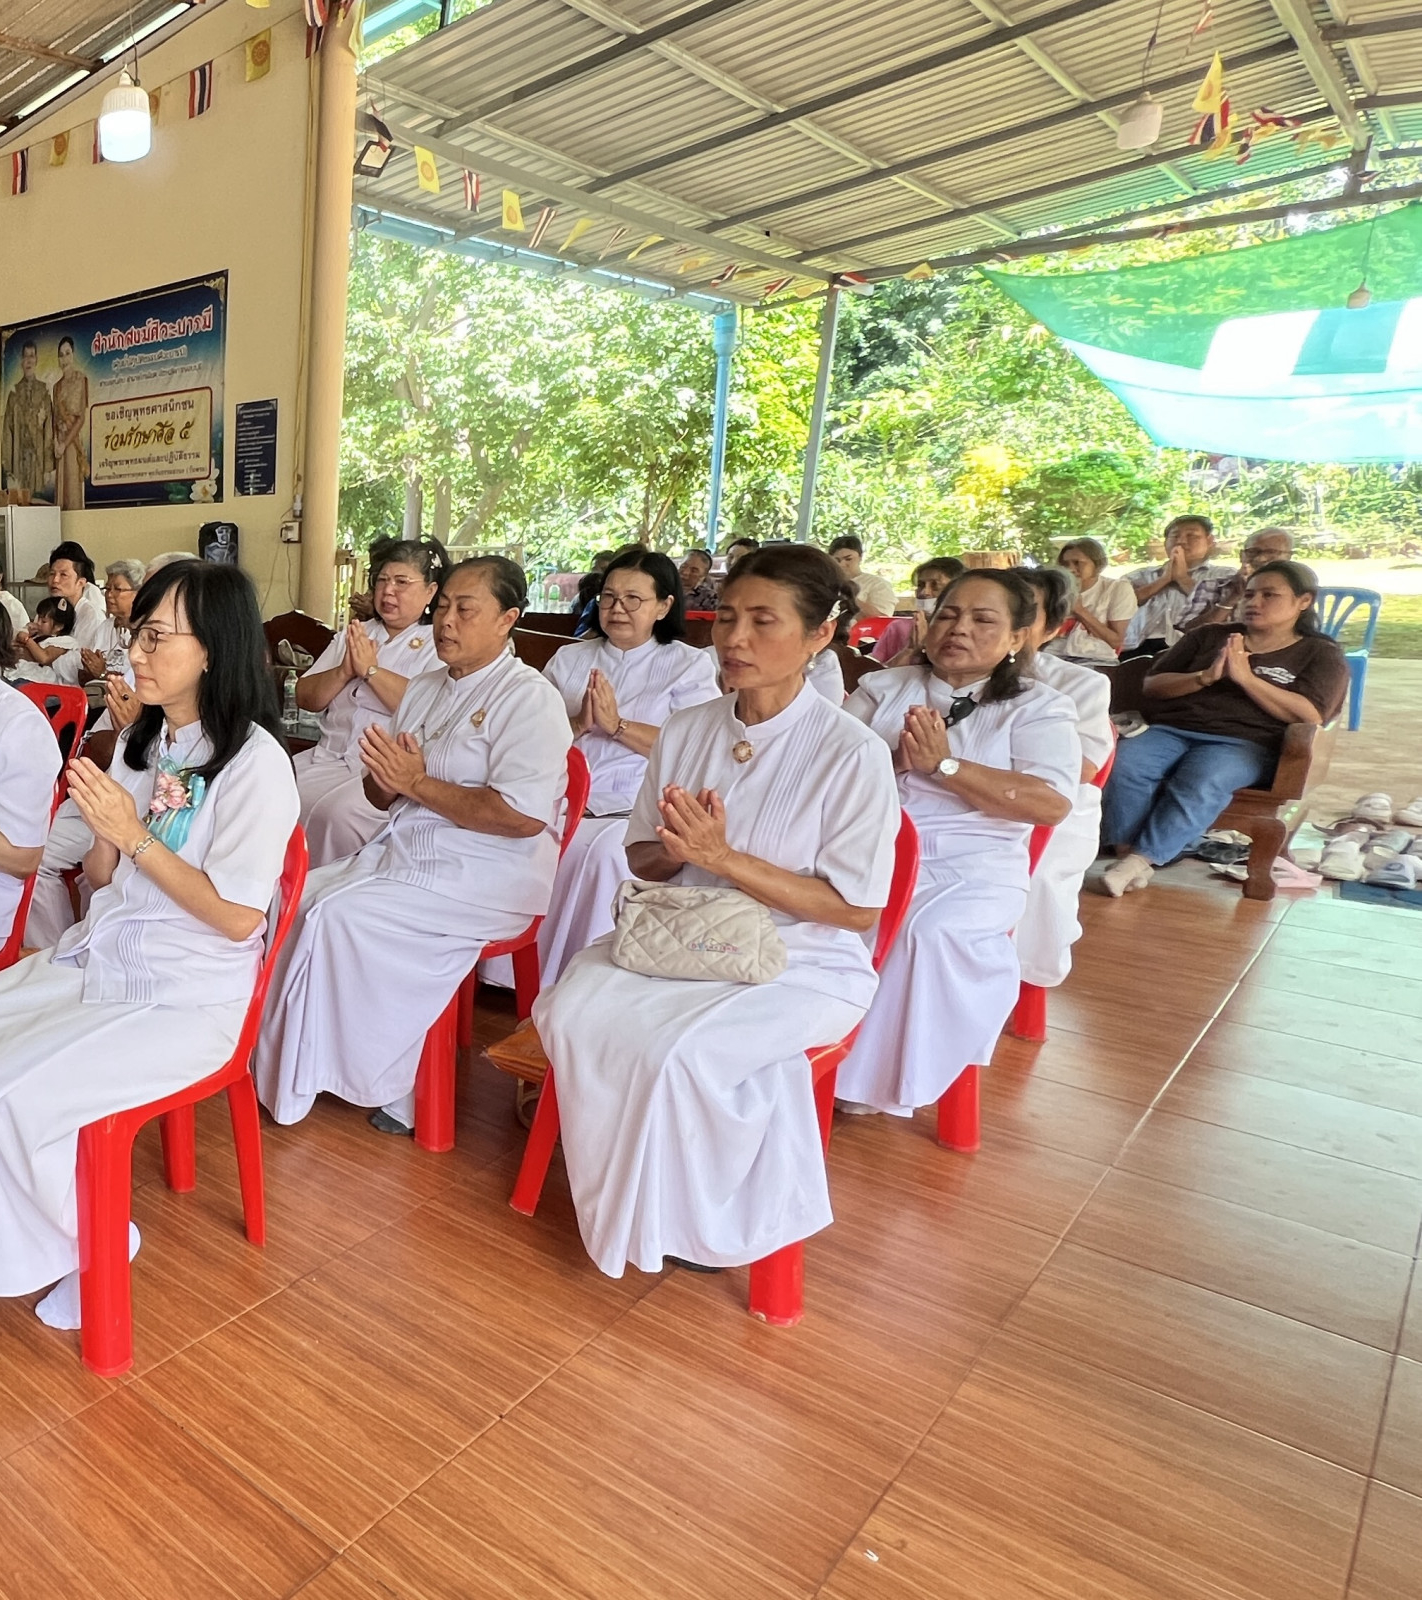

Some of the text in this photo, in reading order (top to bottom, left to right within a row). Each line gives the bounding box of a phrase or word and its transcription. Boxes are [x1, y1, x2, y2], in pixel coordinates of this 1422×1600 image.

[105, 398, 194, 421] ขอเชิญพุทธศาสนิกชน
